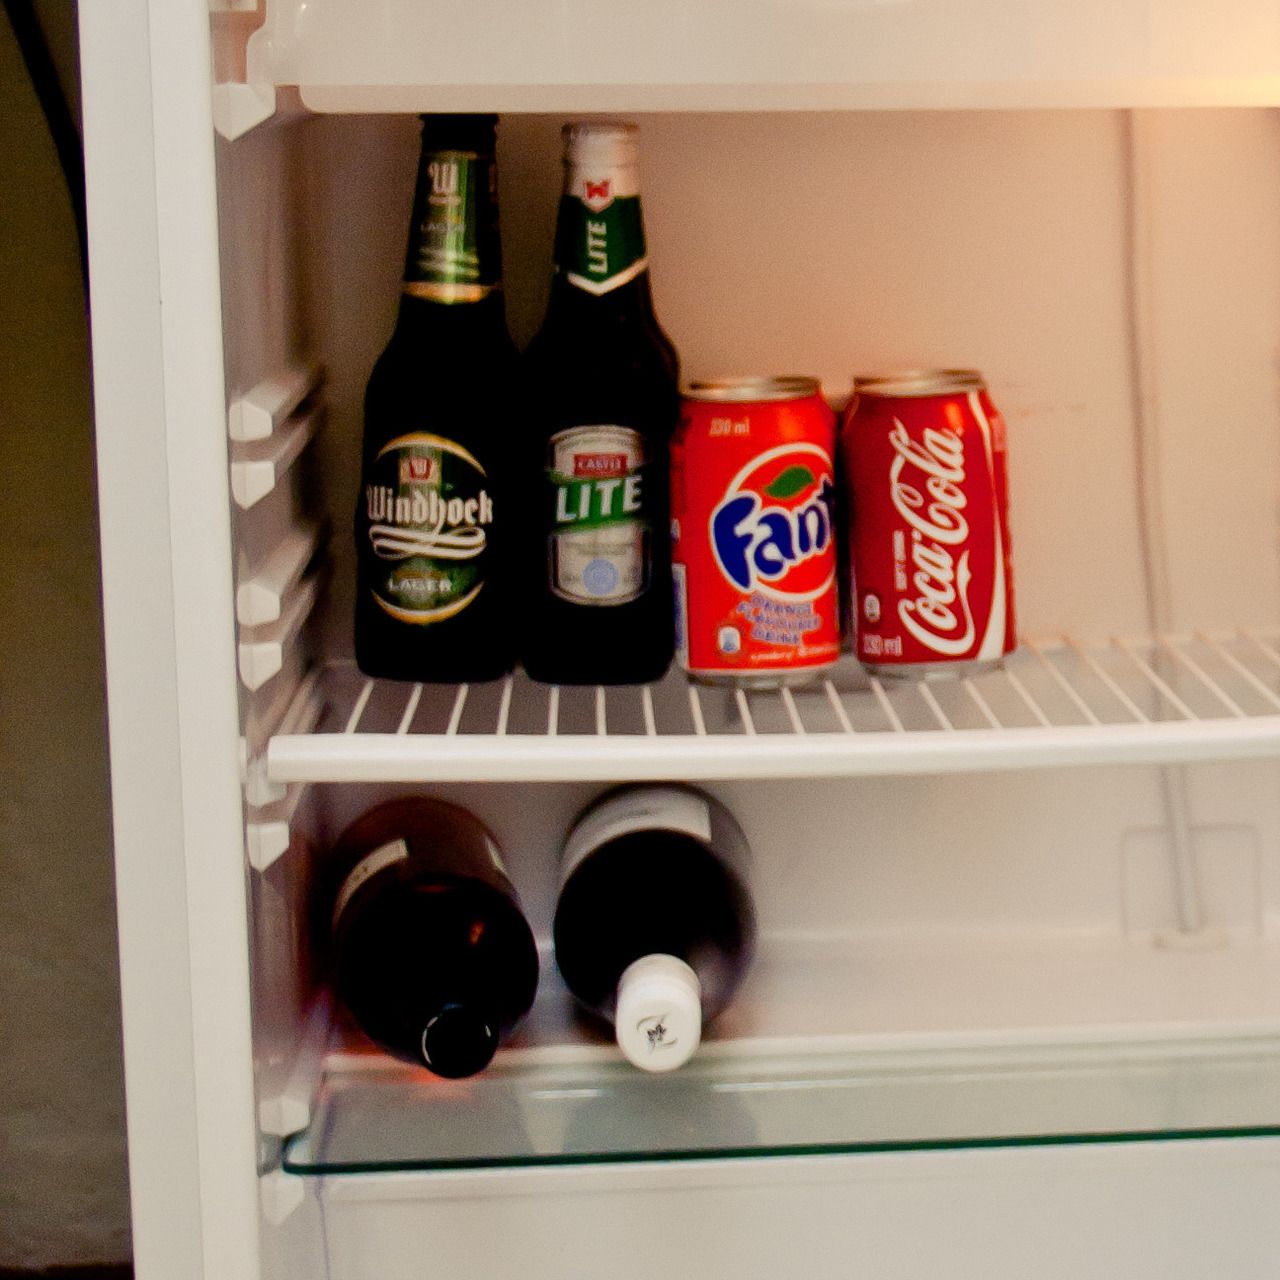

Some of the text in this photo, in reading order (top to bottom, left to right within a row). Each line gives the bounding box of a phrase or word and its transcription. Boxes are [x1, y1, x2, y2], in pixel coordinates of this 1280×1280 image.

[586, 220, 609, 274] LITE
[556, 474, 642, 524] LITE
[888, 415, 976, 657] Coca-Cola
